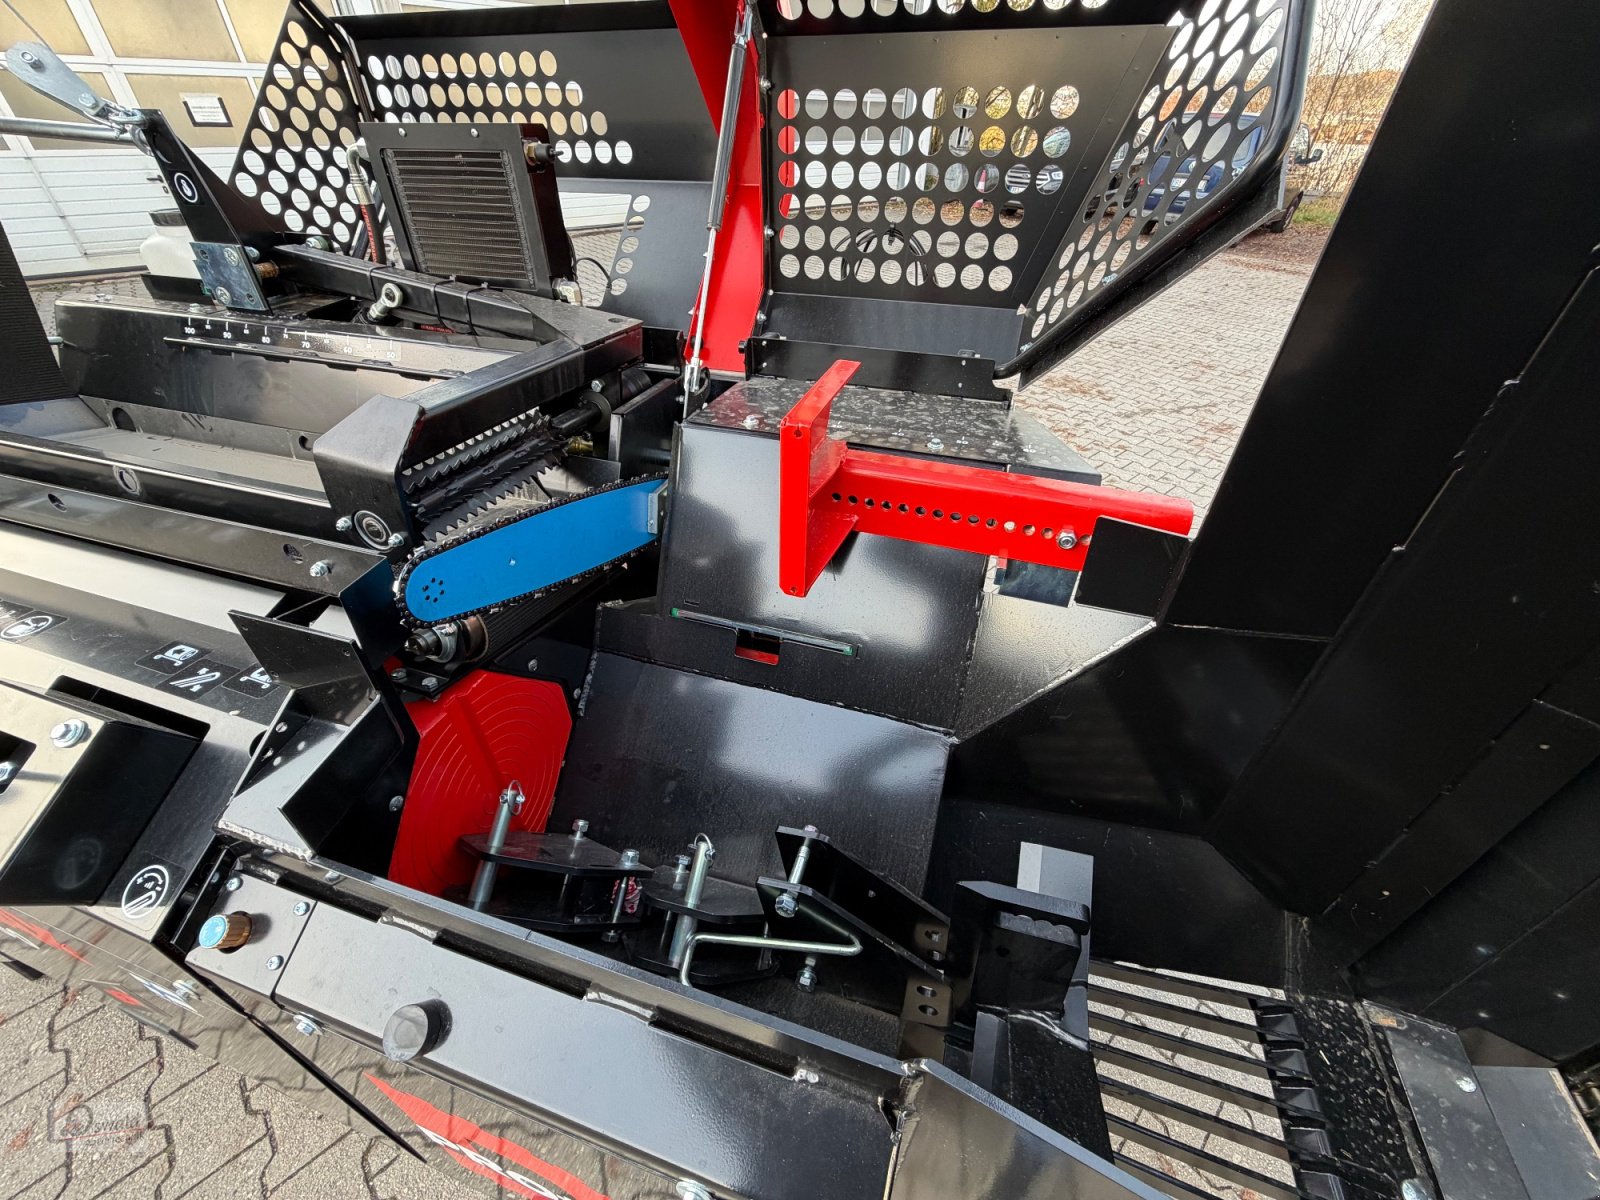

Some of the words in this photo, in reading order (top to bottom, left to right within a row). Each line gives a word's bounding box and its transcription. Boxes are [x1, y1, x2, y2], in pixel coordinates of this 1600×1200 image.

[184, 326, 196, 335] 100
[223, 331, 232, 339] 90
[261, 336, 271, 344] 80
[301, 341, 311, 349] 70
[343, 346, 353, 354] 60
